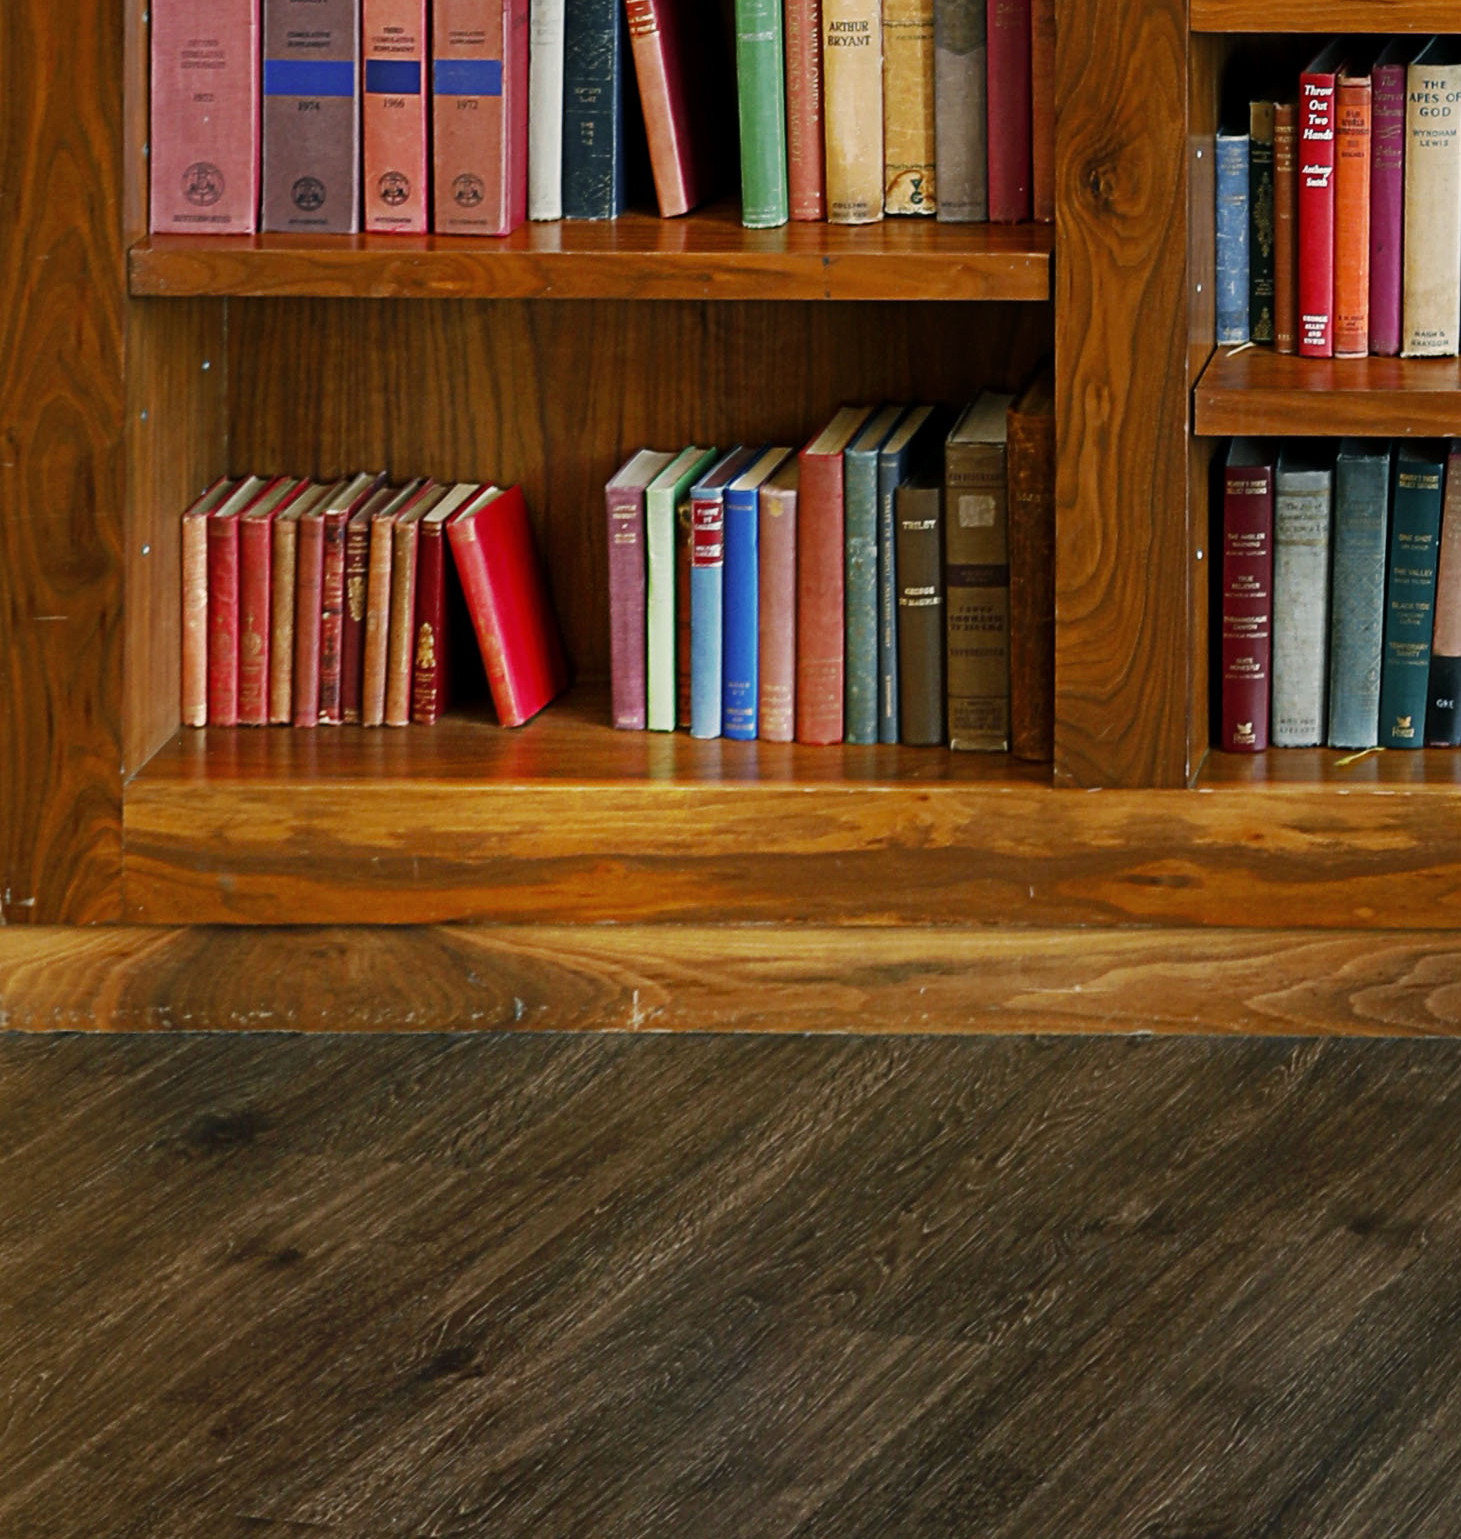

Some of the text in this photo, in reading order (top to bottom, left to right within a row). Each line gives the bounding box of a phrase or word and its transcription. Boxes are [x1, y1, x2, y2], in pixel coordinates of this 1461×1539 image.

[829, 21, 868, 32] ARTHUR
[828, 35, 870, 47] BRYANT
[1424, 80, 1446, 90] THE
[1409, 92, 1461, 103] APES OF
[1309, 100, 1327, 110] Out
[1420, 107, 1451, 117] GOD
